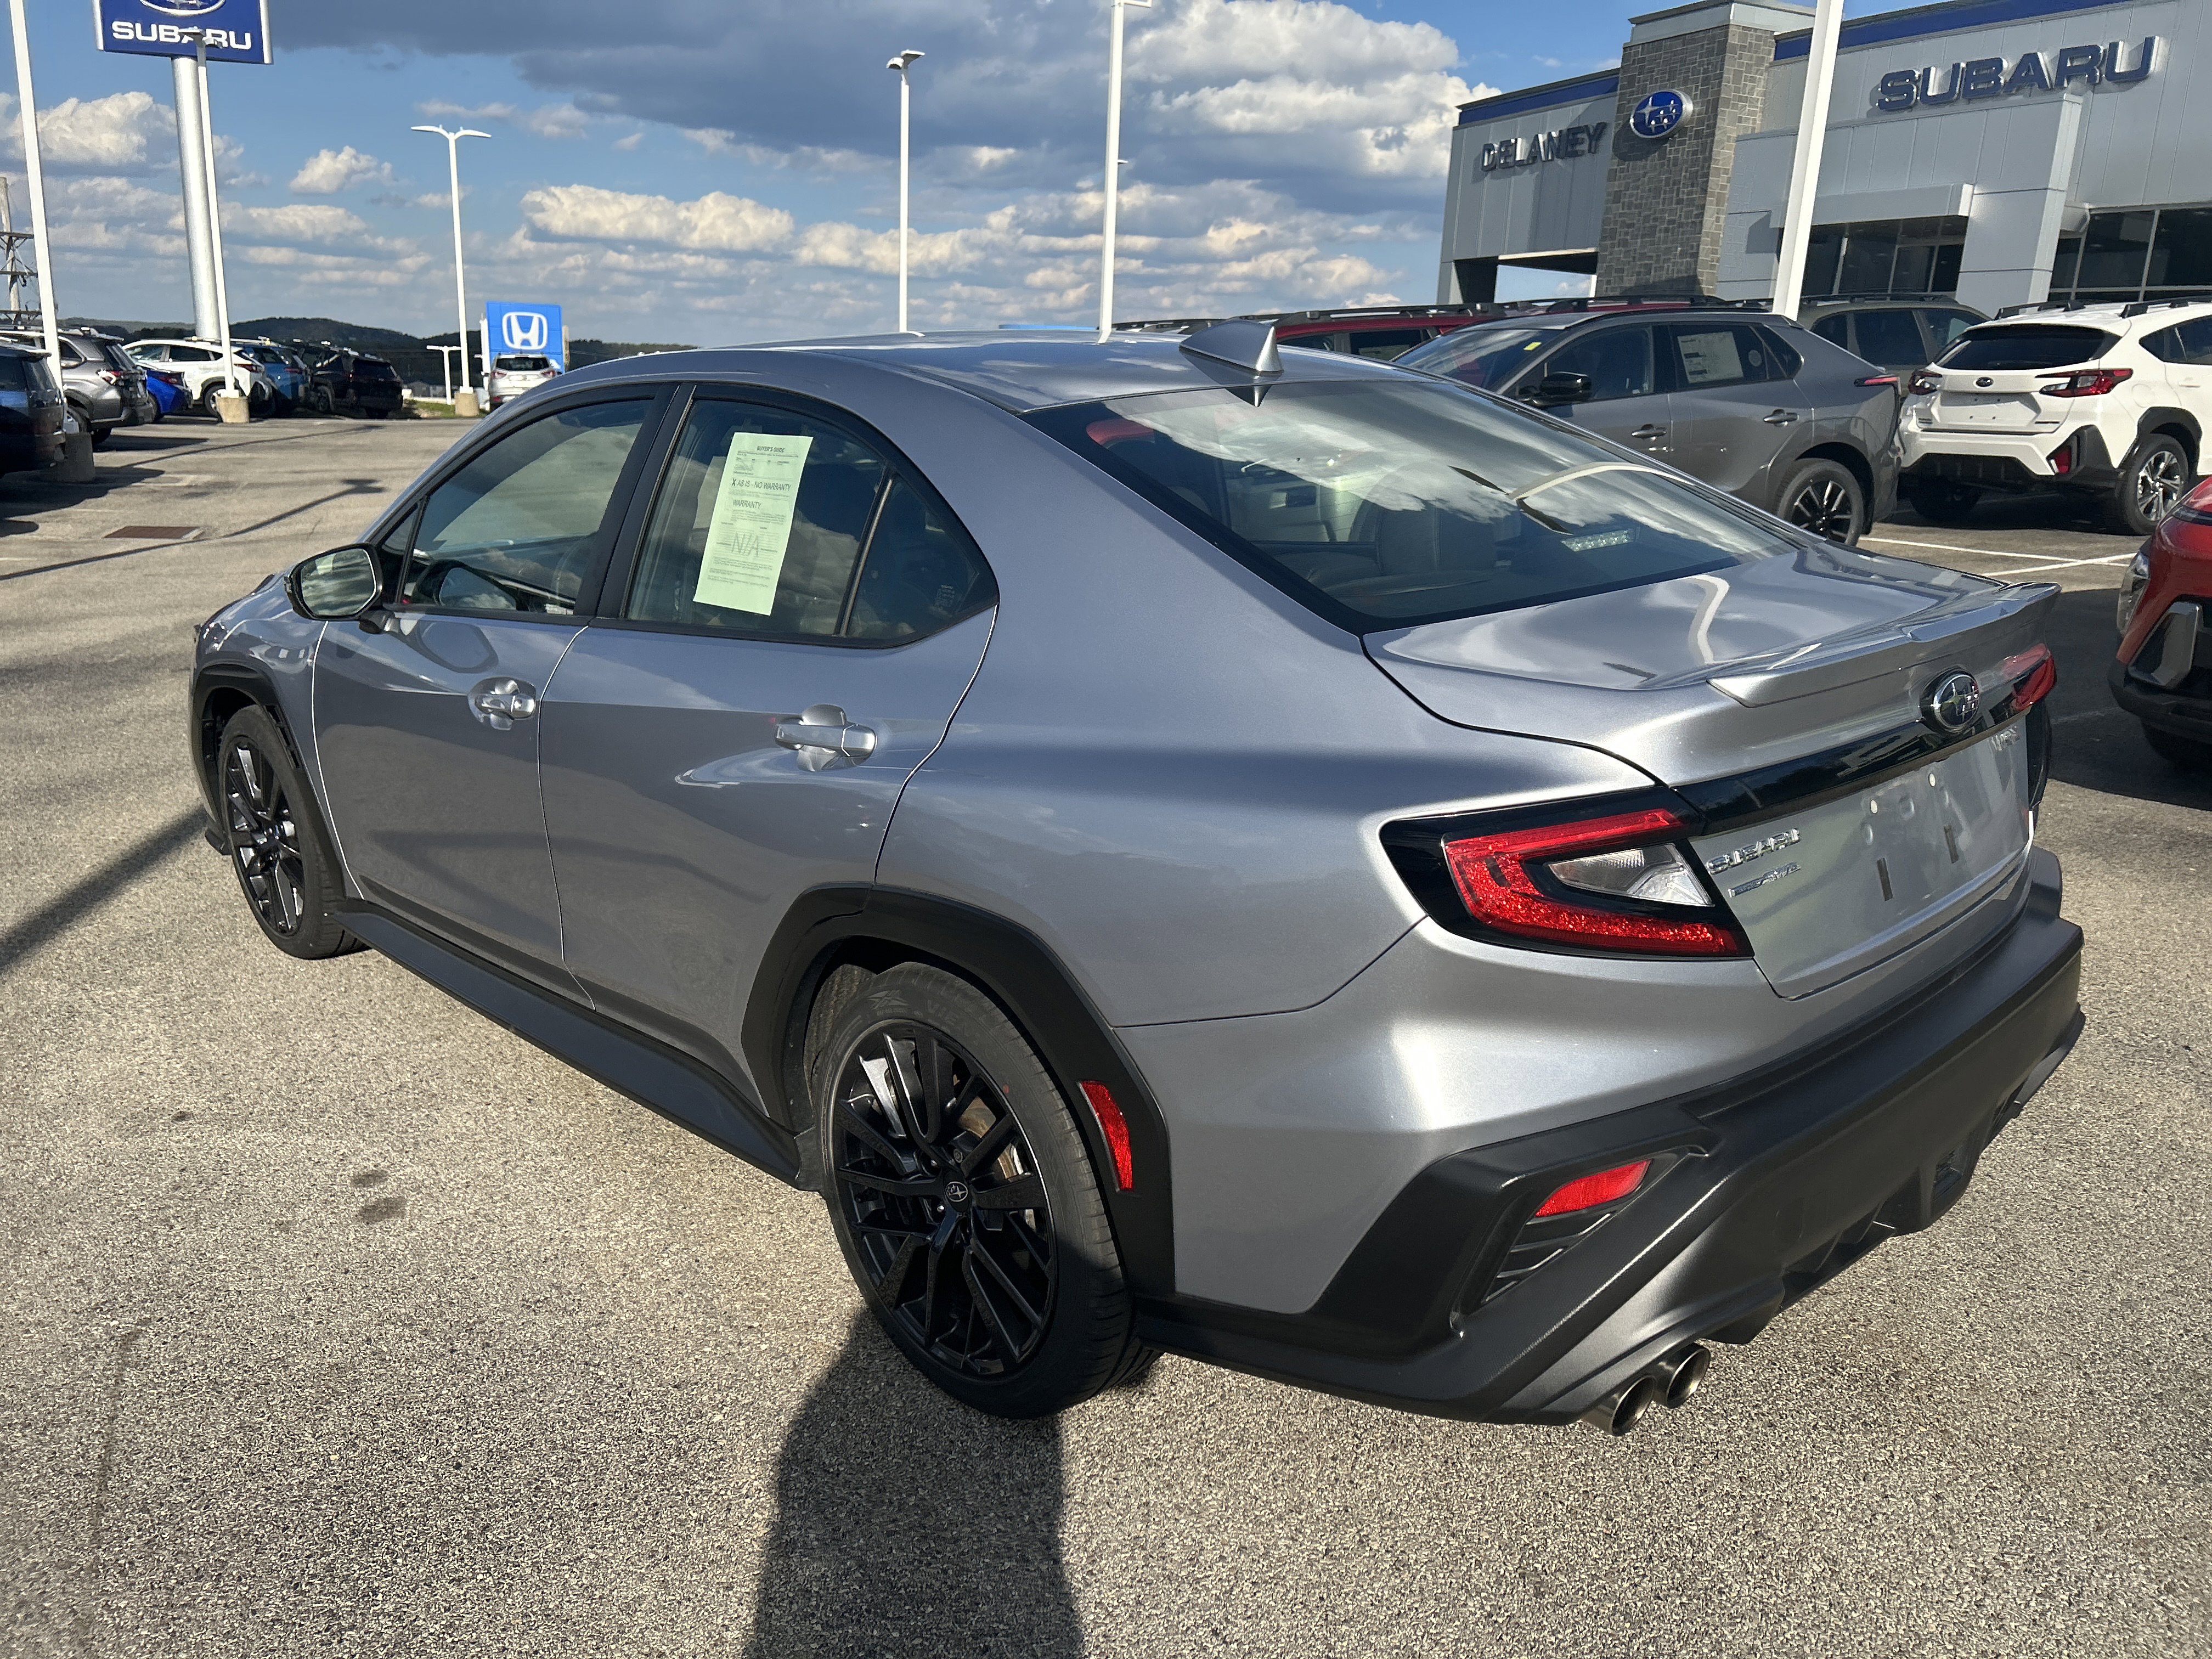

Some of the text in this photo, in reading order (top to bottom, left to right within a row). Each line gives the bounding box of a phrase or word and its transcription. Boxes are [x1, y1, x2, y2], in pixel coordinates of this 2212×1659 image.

[1877, 36, 2160, 110] SUBARU
[1481, 122, 1607, 172] DELANEY
[731, 478, 737, 487] X
[763, 483, 791, 491] WARRANTY
[733, 499, 761, 509] WARRANTY
[731, 532, 759, 557] N/A
